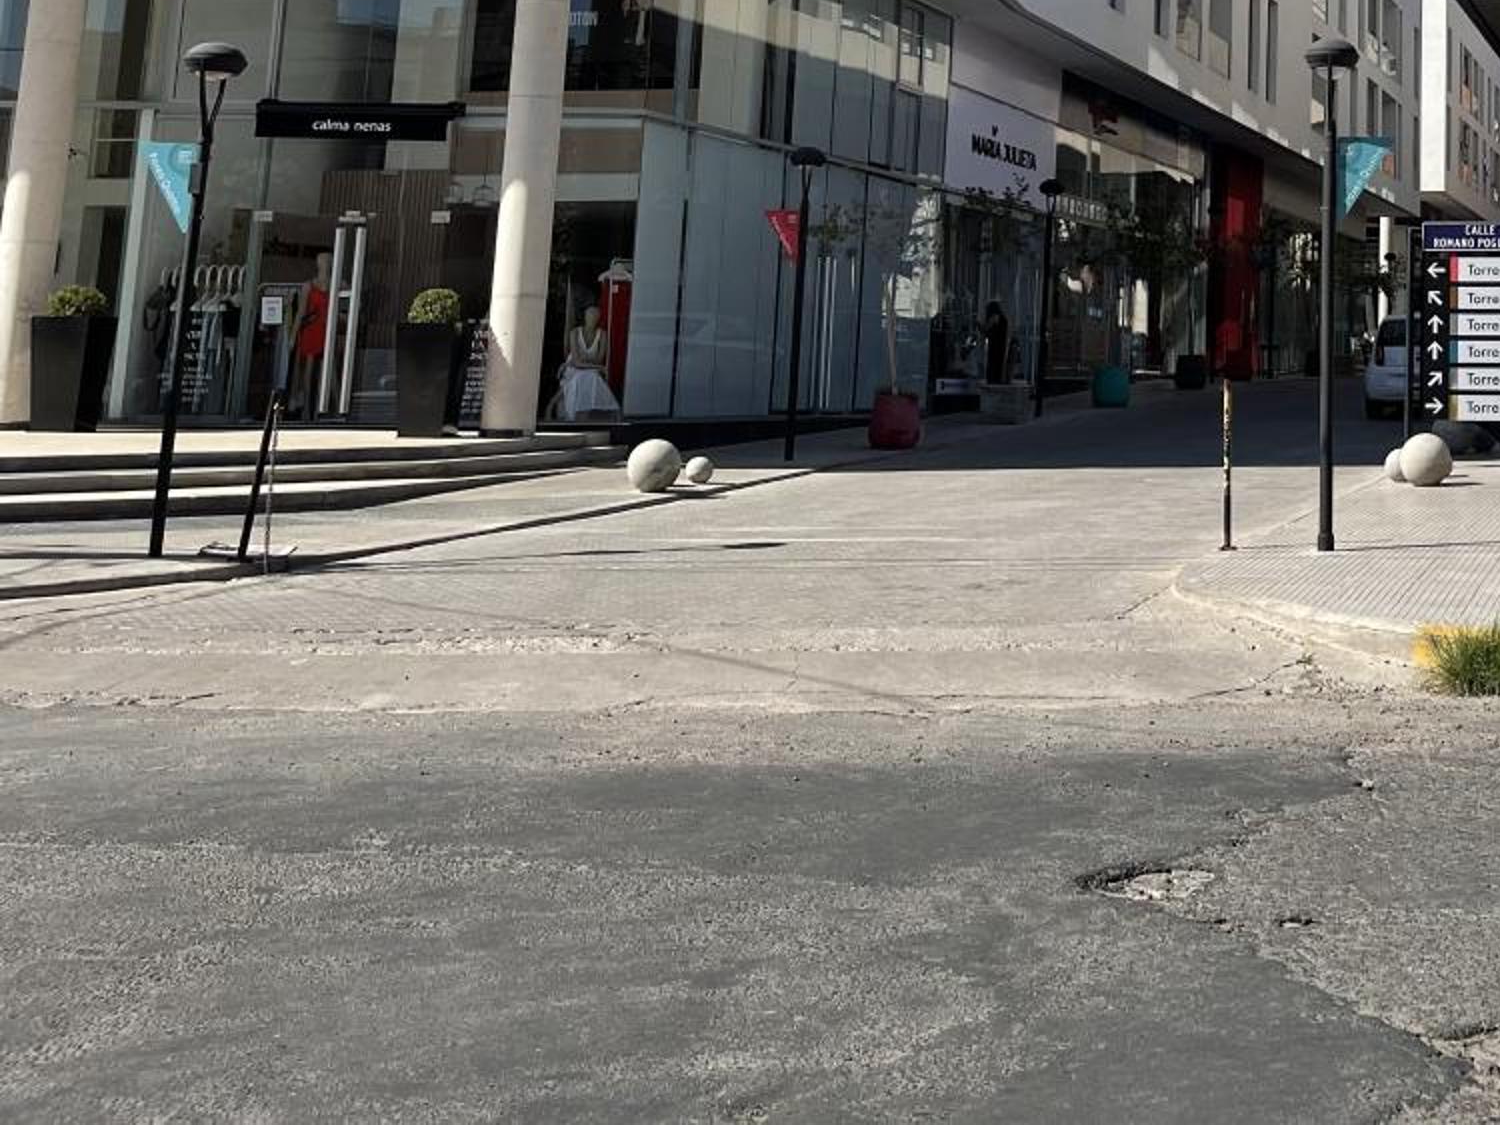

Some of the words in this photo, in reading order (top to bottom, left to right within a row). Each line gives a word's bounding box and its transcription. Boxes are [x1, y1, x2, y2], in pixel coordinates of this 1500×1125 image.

[312, 119, 349, 131] calma
[353, 121, 392, 132] nenas
[1003, 142, 1037, 172] JULIETA
[1465, 224, 1495, 236] CALLE
[1433, 237, 1475, 248] ROMANO
[1469, 264, 1500, 276] Torre
[1468, 292, 1500, 304] Torre
[1468, 319, 1500, 331] Torre
[1468, 346, 1500, 358] Torre
[1468, 374, 1500, 386] Torre
[1468, 402, 1500, 414] Torre
